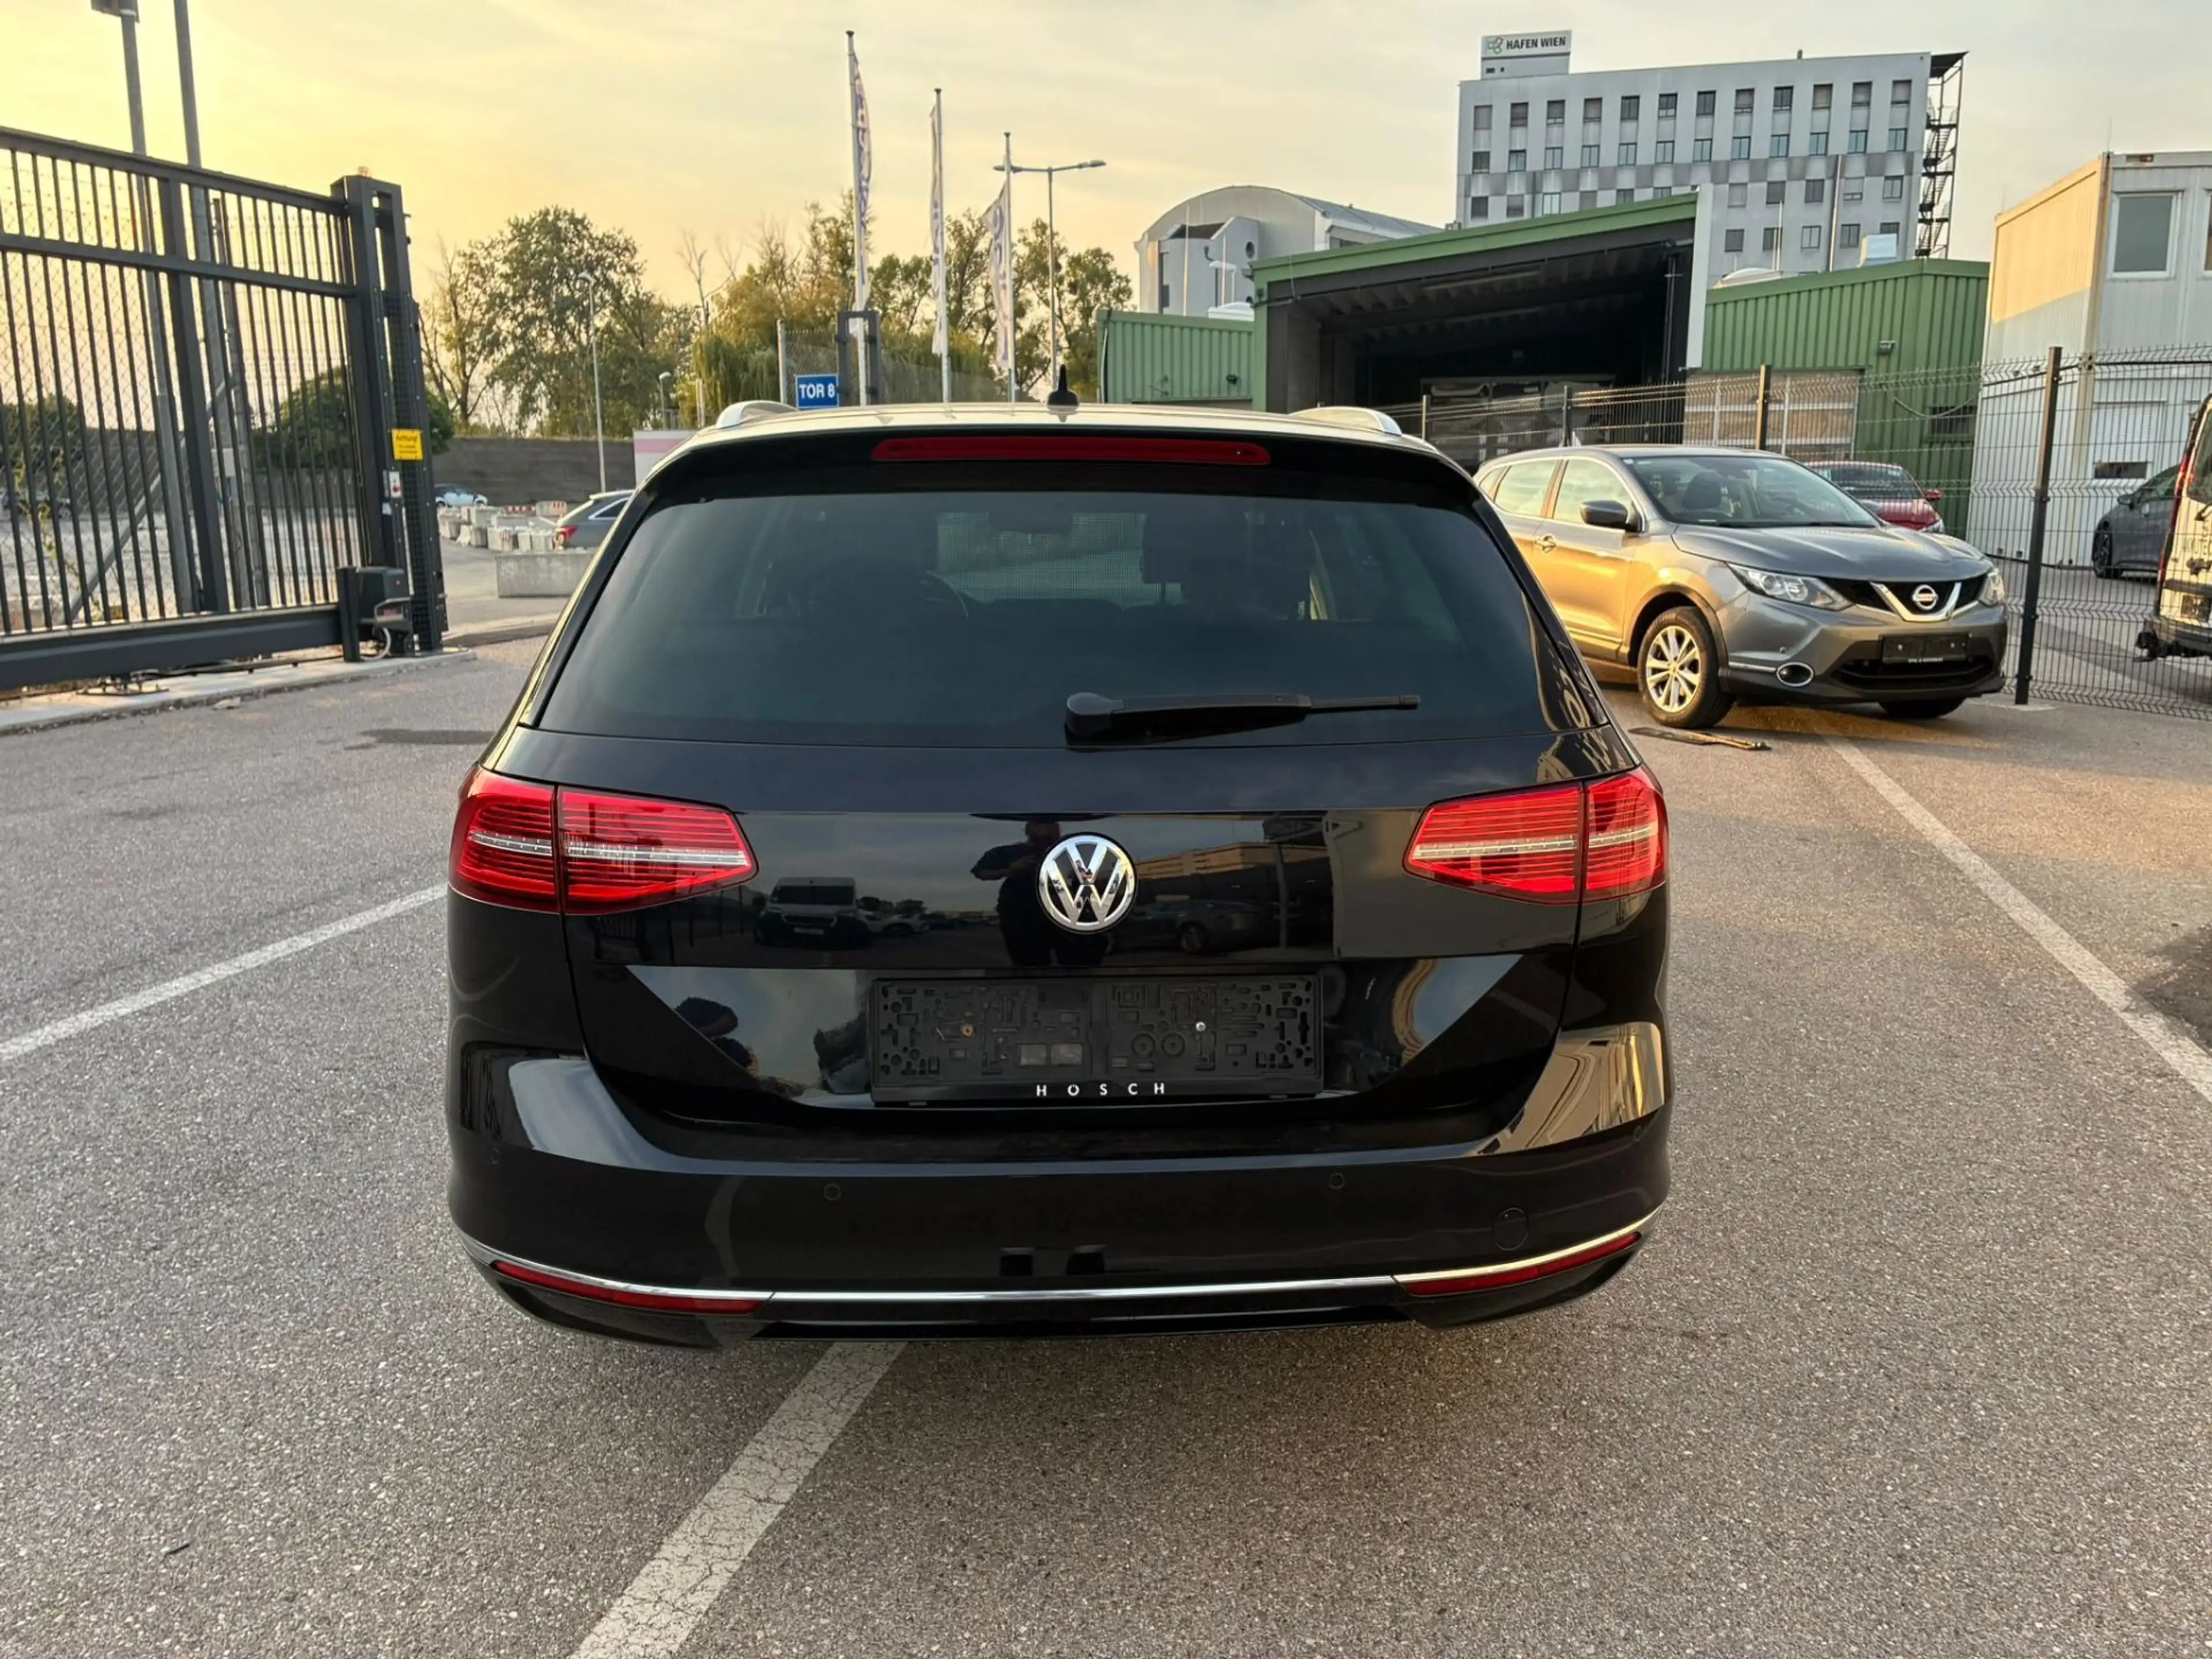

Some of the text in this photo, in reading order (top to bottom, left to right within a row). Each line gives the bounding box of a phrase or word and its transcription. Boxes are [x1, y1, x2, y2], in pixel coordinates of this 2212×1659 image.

[1506, 36, 1566, 50] HAFEN WIEN
[799, 382, 835, 399] TOR 8
